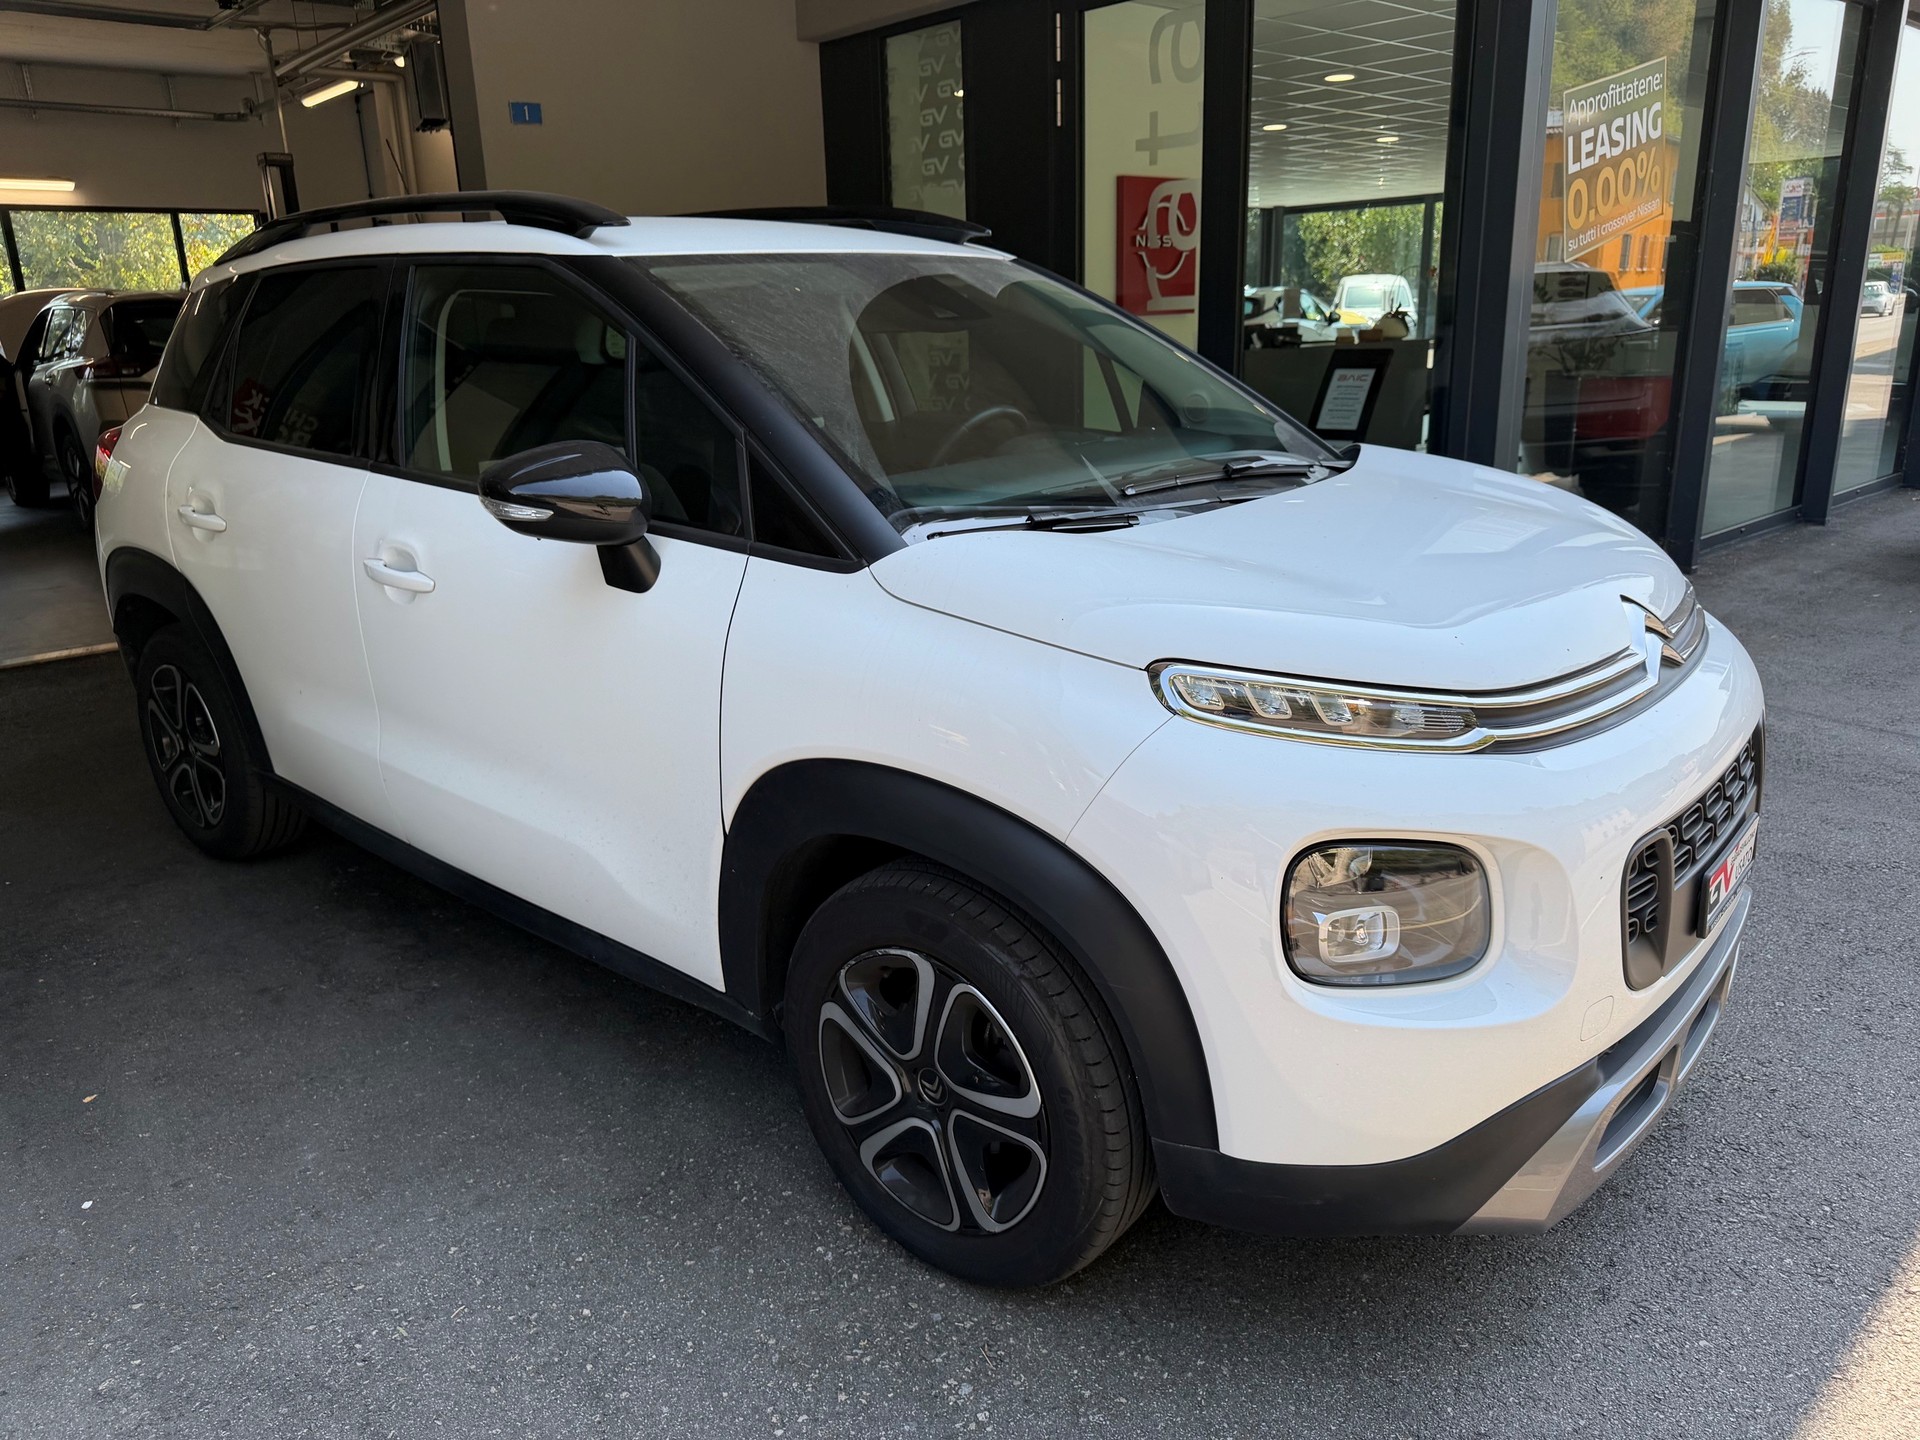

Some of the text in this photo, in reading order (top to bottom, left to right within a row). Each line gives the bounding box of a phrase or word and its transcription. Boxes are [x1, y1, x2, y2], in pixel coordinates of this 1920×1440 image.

[523, 104, 529, 121] 1
[920, 104, 947, 127] GV
[1568, 73, 1663, 126] Approfittatene:
[1567, 101, 1662, 175] LEASING
[921, 154, 949, 176] GV
[1567, 147, 1661, 230] 0.00%
[1568, 238, 1579, 252] su
[1579, 226, 1597, 246] tutti
[1600, 209, 1637, 236] crossover
[1637, 198, 1660, 217] Nissan
